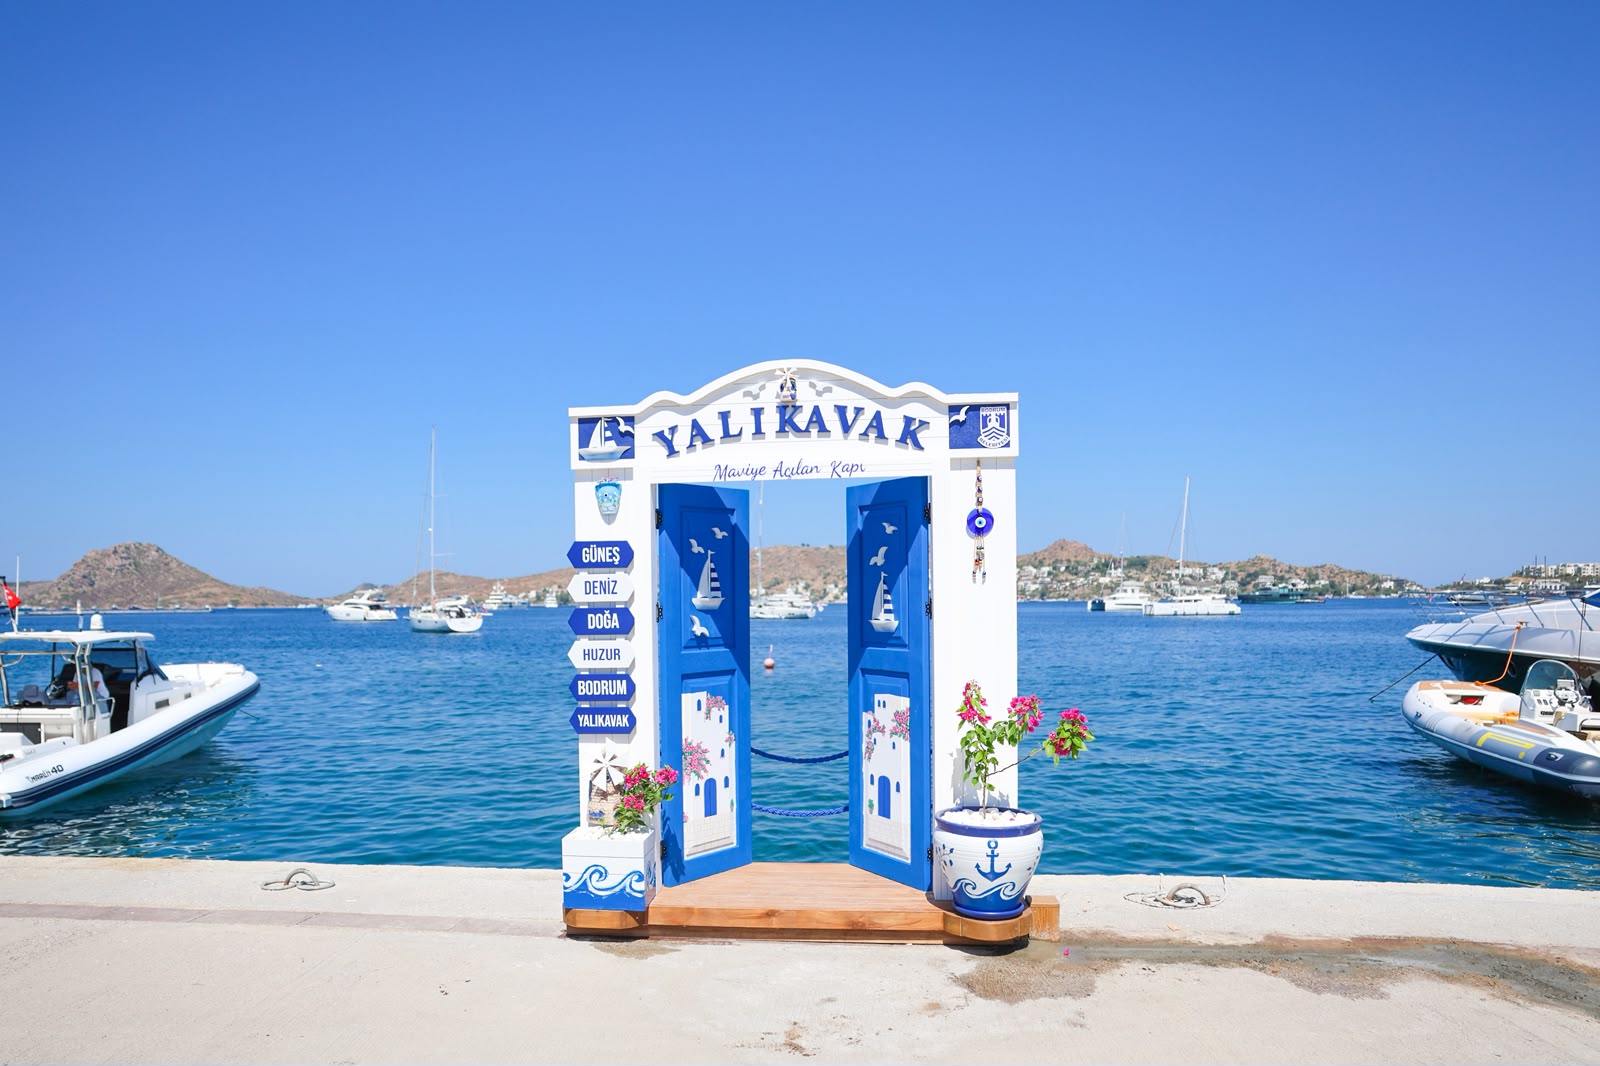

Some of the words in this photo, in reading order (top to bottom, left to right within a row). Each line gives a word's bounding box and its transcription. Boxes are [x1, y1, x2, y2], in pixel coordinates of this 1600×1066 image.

[651, 404, 931, 458] YALIKAVAK
[713, 463, 767, 482] Maviye
[773, 458, 821, 480] Açılan
[830, 460, 866, 479] Kapı
[581, 545, 620, 565] GÜNEŞ
[584, 577, 618, 595] DENİZ
[587, 609, 620, 629] DOĞA
[583, 648, 621, 661] HUZUR
[577, 679, 628, 696] BODRUM
[577, 714, 629, 728] YALIKAVAK
